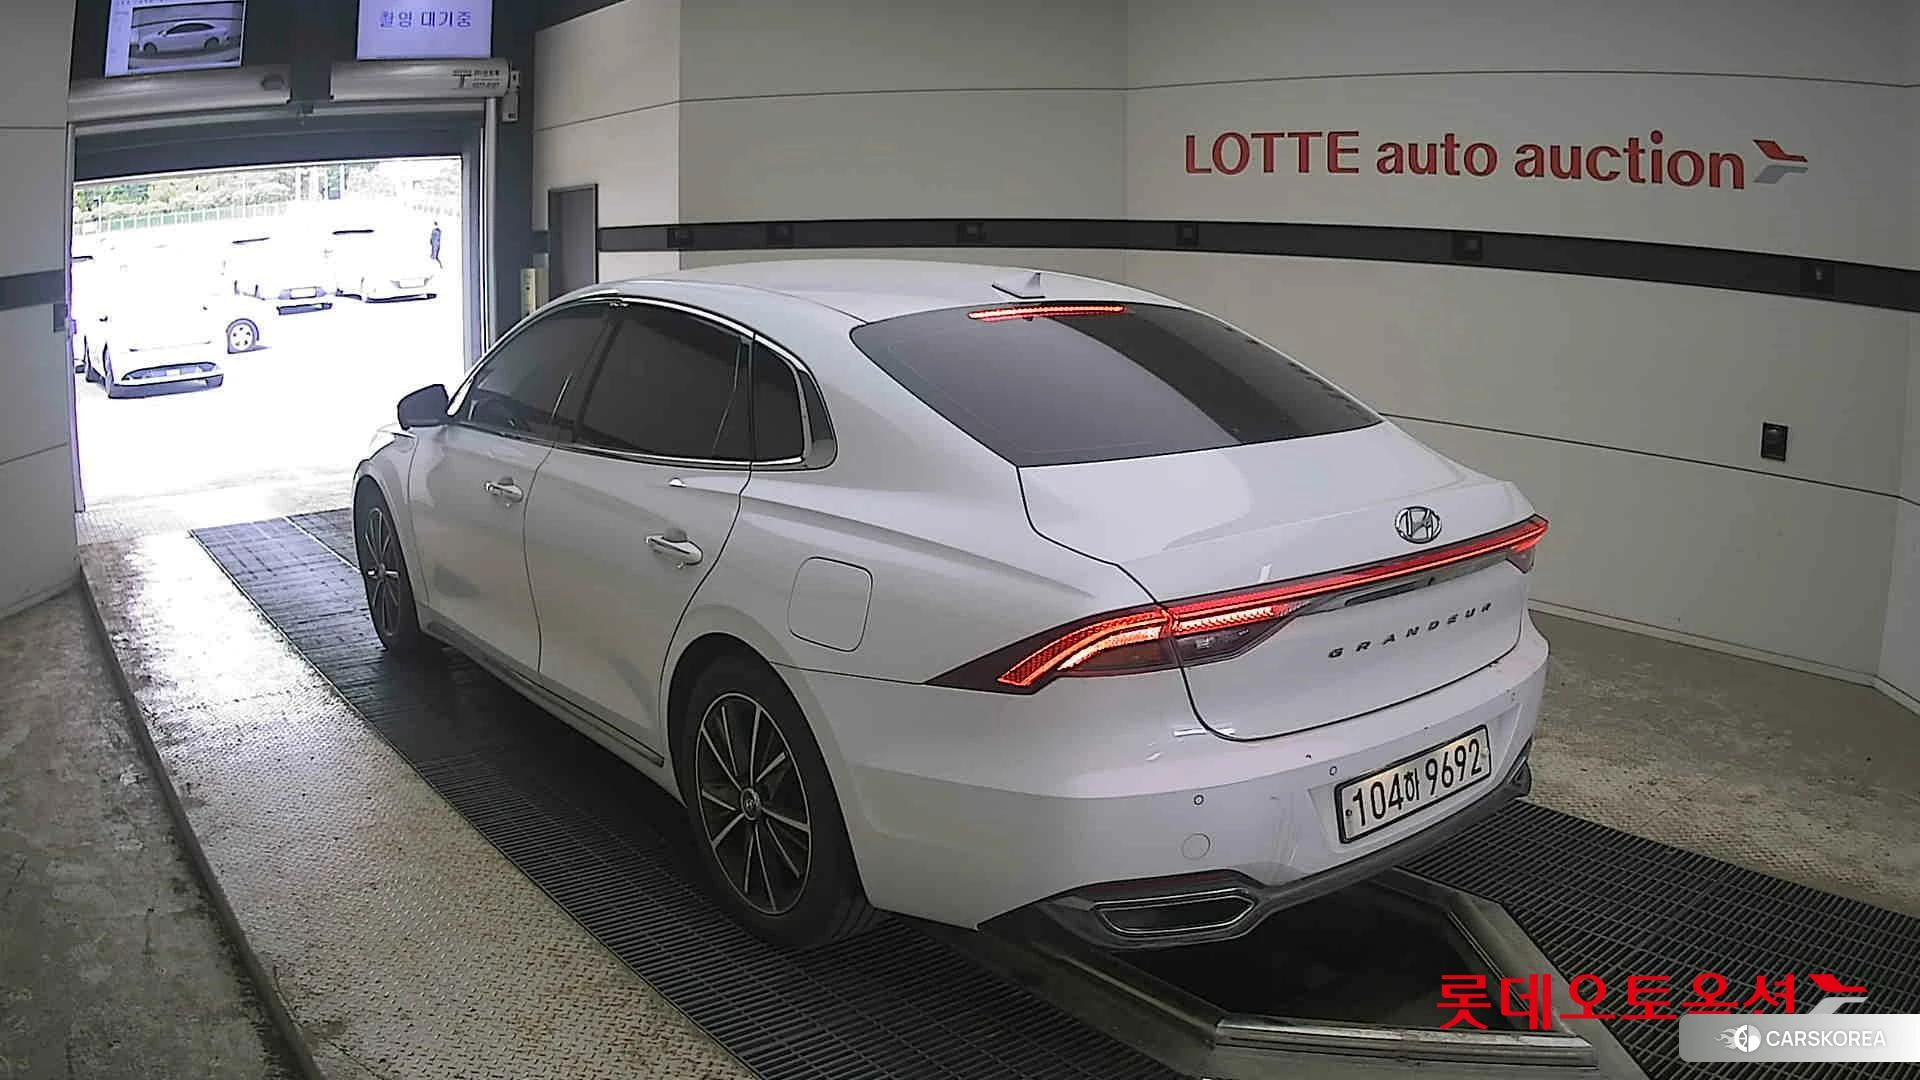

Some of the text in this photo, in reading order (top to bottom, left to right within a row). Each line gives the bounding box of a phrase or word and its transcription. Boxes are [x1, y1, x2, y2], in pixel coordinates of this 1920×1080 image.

[420, 10, 471, 28] 대기중
[1185, 130, 1745, 189] LOTTE auto auction
[1328, 603, 1493, 659] GRANDEUR
